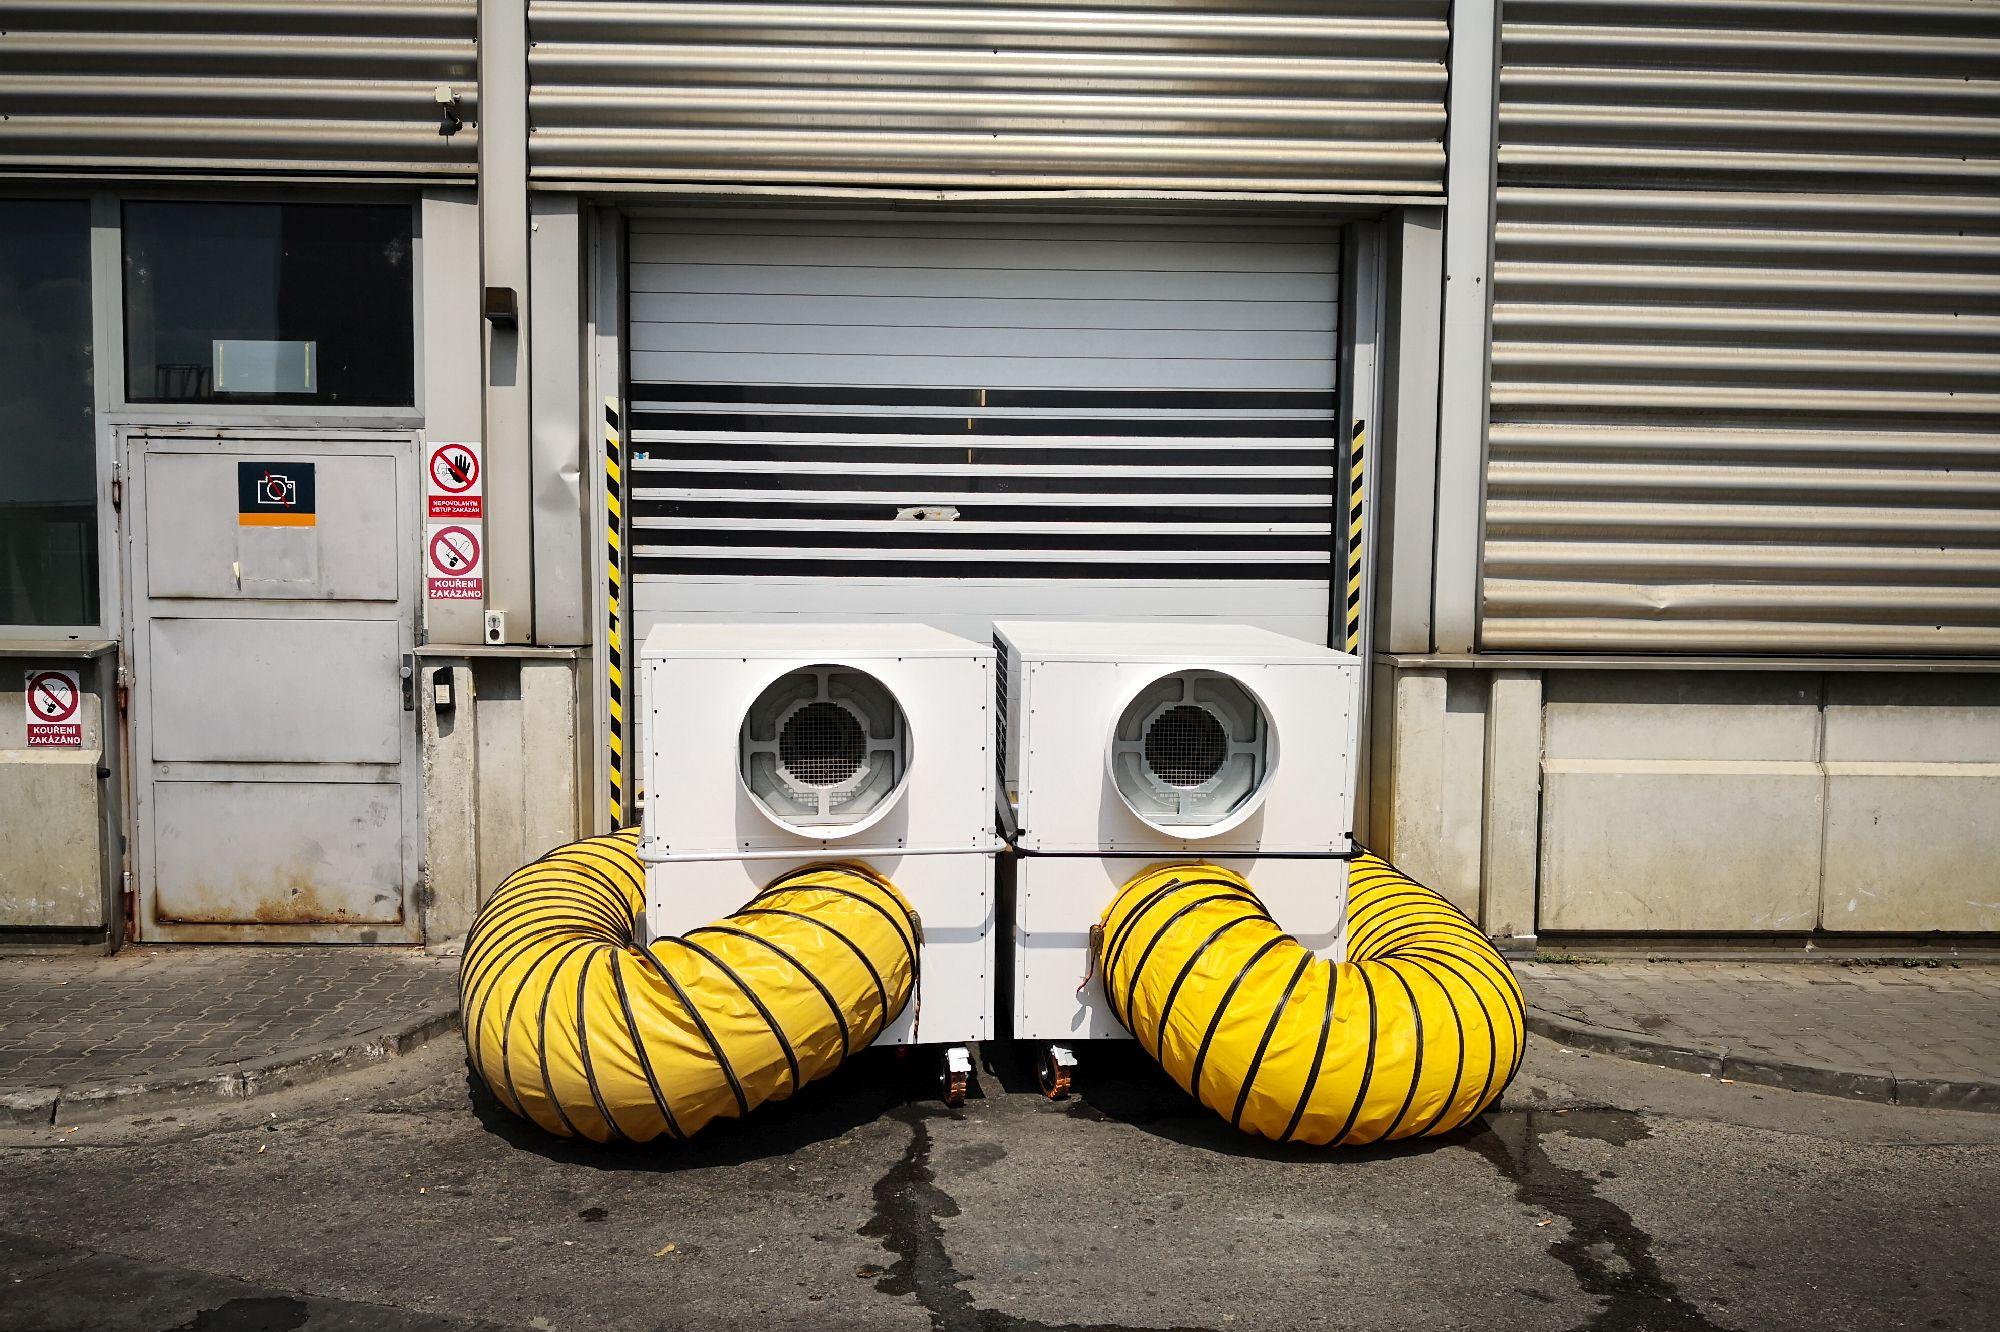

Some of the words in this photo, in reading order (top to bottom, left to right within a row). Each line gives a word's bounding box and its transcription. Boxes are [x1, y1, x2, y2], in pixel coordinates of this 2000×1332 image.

[435, 579, 477, 588] KOUŘENÍ
[430, 589, 481, 598] ZAKÁZÁNO
[33, 725, 76, 734] KOUŘENÍ
[29, 735, 80, 744] ZAKÁZÁNO
